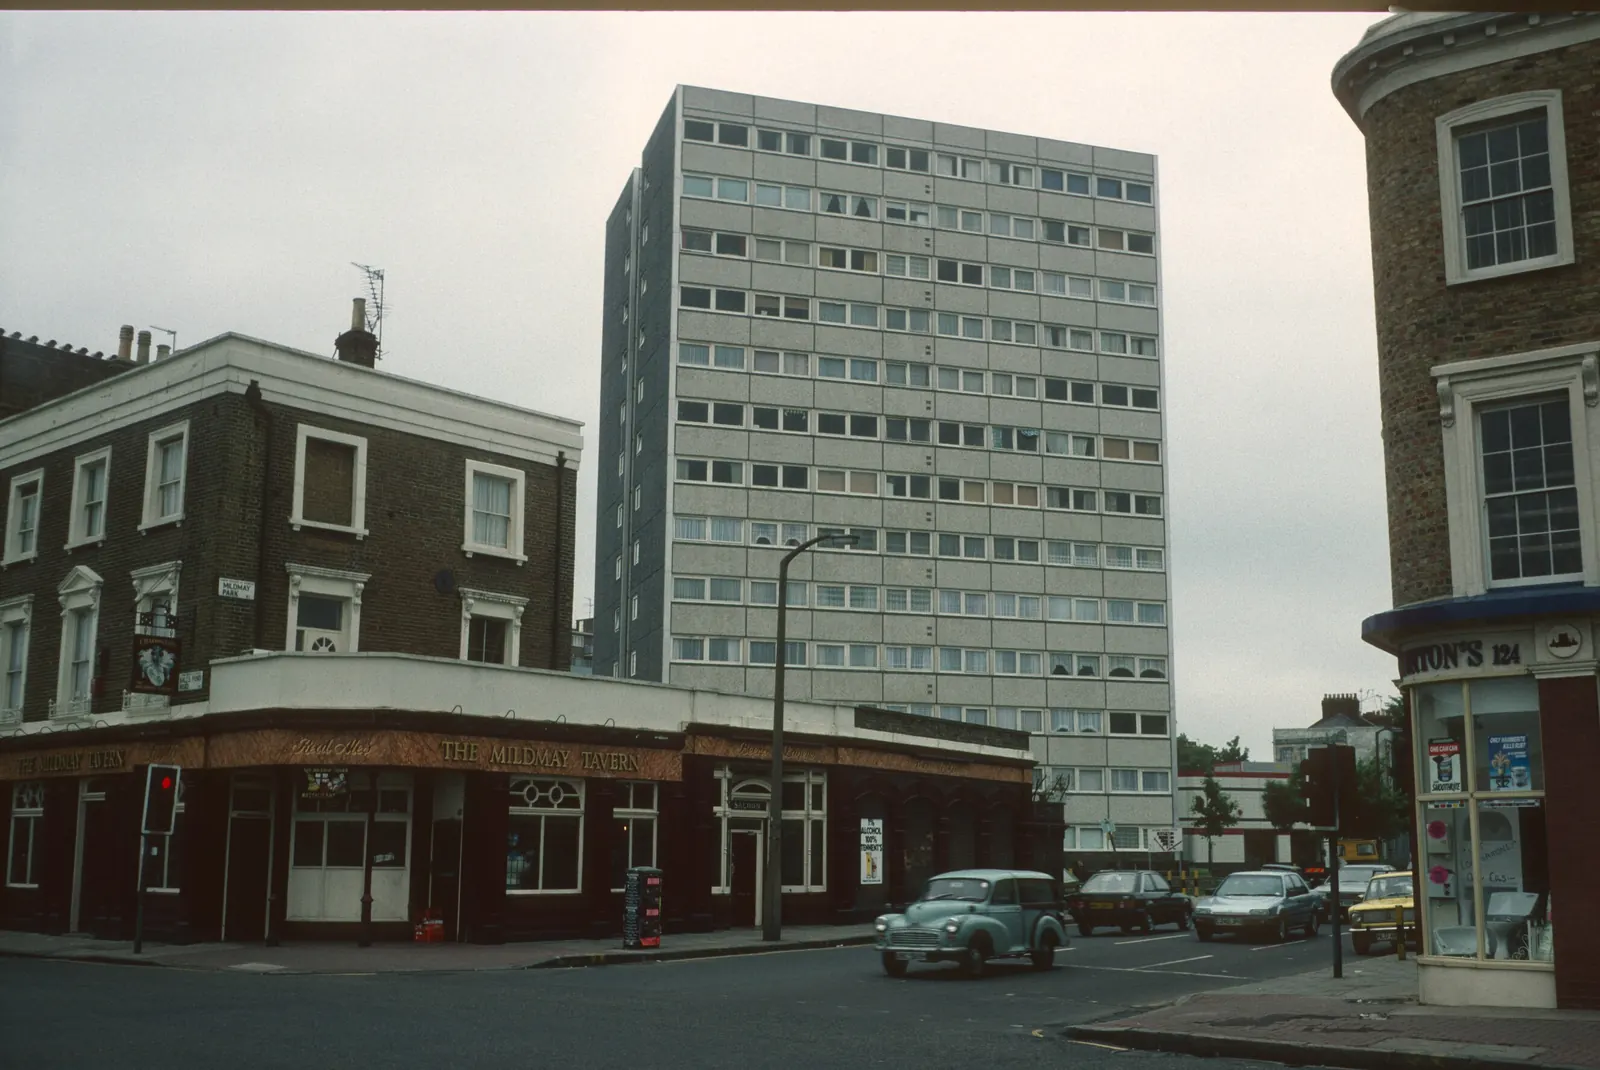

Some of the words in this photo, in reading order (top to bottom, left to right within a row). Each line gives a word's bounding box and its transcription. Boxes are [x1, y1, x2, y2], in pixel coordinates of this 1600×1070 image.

[223, 582, 251, 591] MILDMAY
[1492, 643, 1520, 665] 124
[292, 737, 332, 755] Real
[334, 738, 372, 756] Ales
[16, 757, 35, 774] THE
[38, 752, 82, 771] MILDMAY
[87, 749, 126, 768] TAVERN
[441, 740, 480, 761] THE
[489, 745, 572, 768] MILDMAY
[580, 751, 640, 772] TAVERN
[733, 801, 761, 809] SALOON
[860, 827, 882, 835] ALCOHOL
[865, 835, 877, 843] 100%
